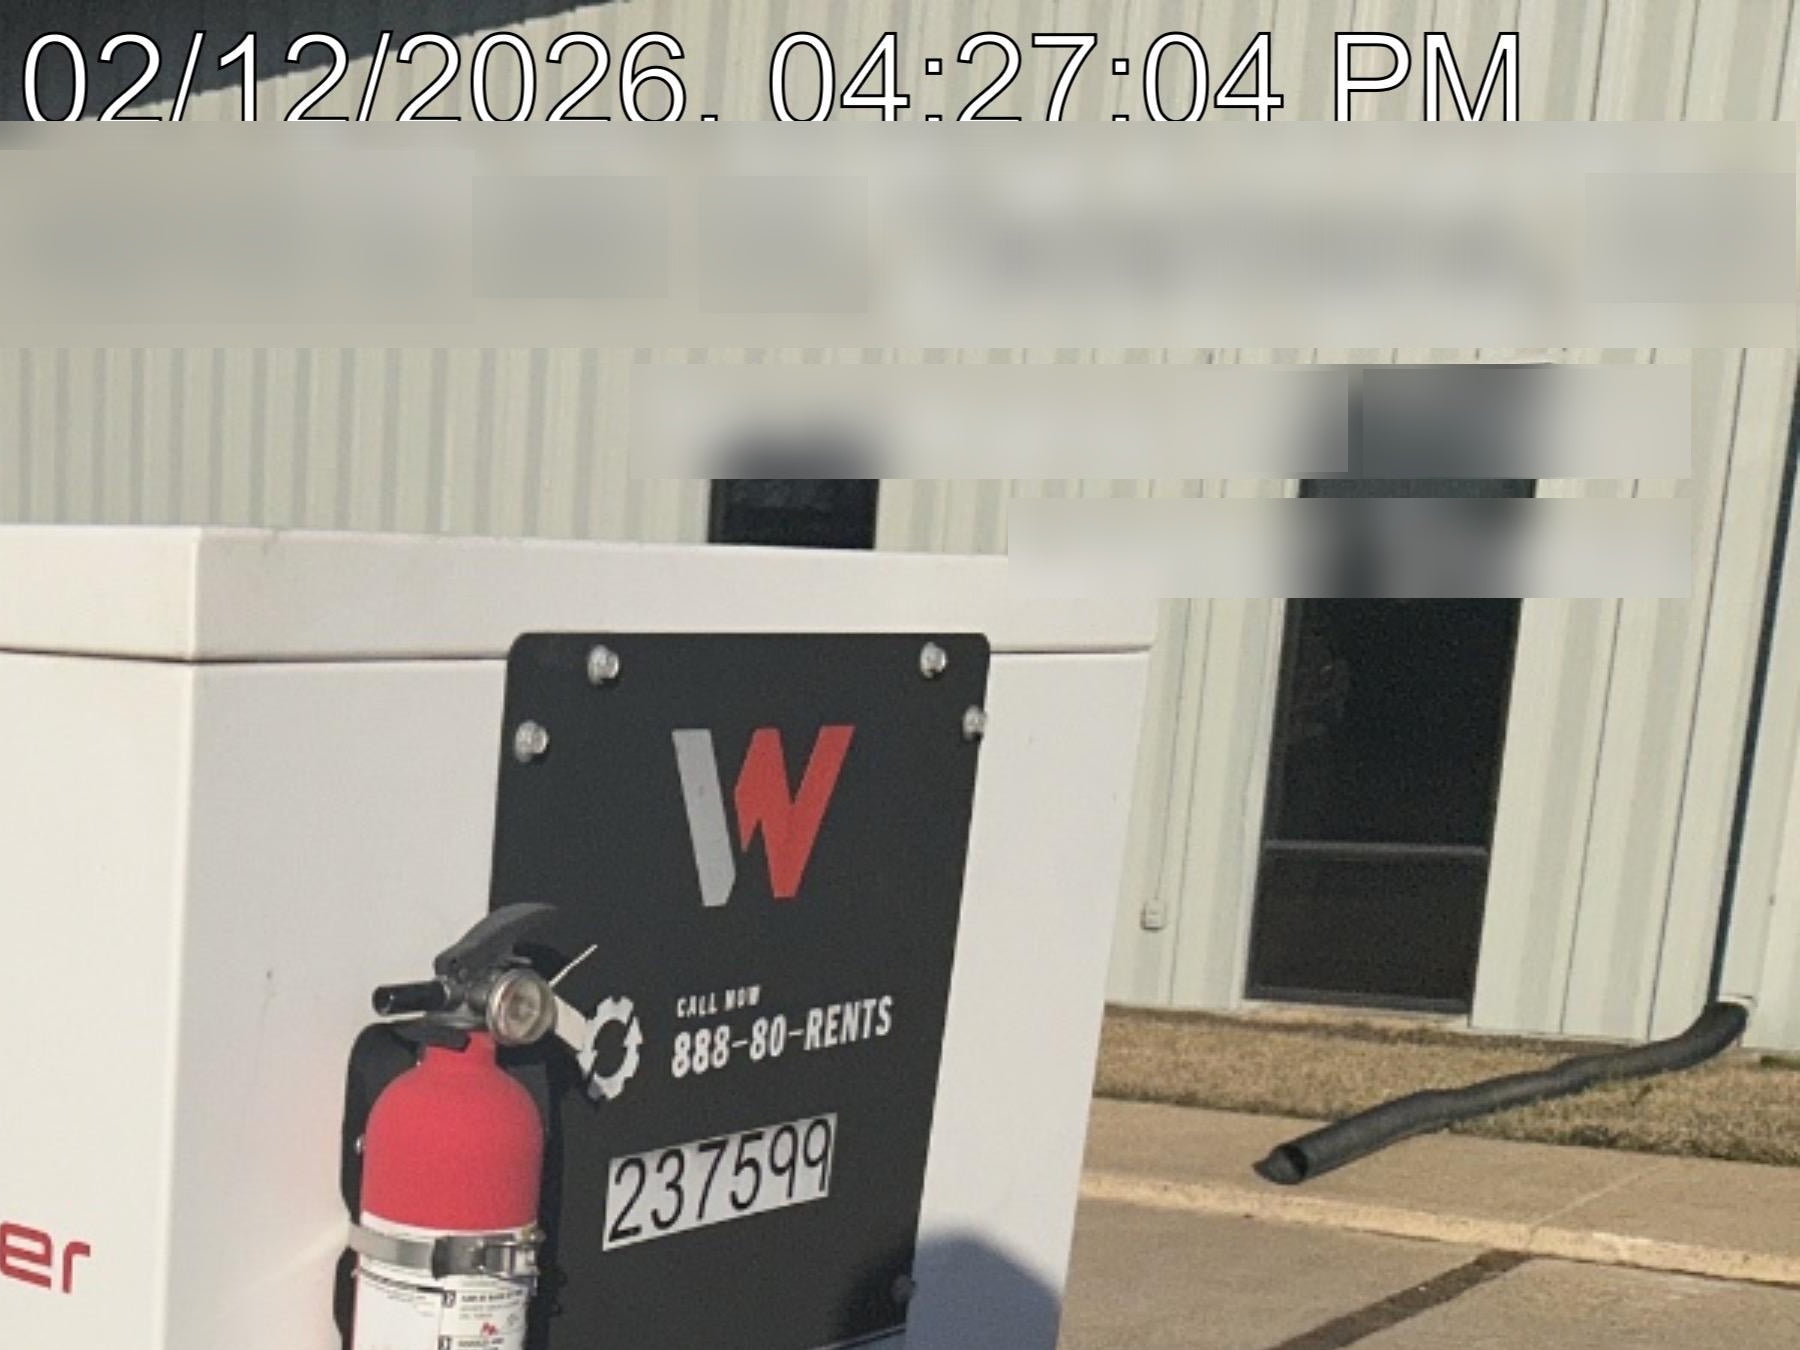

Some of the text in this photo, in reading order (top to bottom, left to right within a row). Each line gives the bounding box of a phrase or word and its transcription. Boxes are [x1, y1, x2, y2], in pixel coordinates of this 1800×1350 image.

[671, 995, 893, 1078] 888-80-RENTS
[676, 984, 761, 1018] CALL NOW
[609, 1118, 831, 1242] 237599
